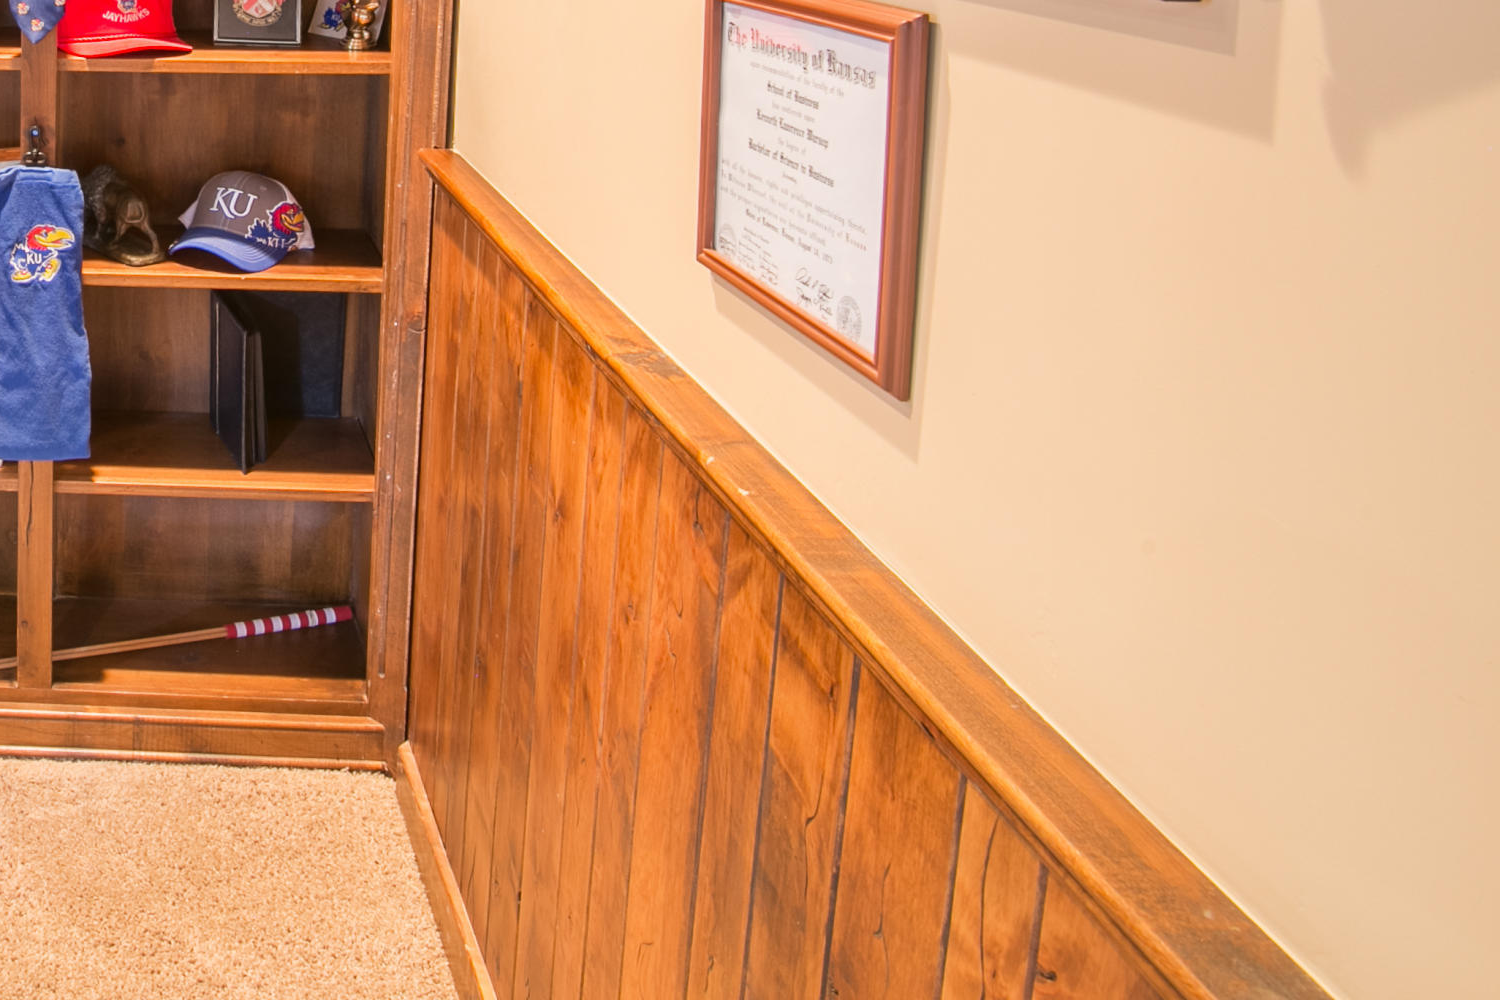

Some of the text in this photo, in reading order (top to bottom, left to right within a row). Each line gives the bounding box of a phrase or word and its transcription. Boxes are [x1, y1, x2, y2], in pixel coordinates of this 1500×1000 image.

[102, 8, 150, 23] JAYHAWKS
[728, 21, 748, 49] The
[750, 27, 808, 72] University
[811, 49, 824, 71] of
[826, 48, 877, 89] Kansas
[209, 187, 258, 219] KU
[26, 253, 42, 265] KU
